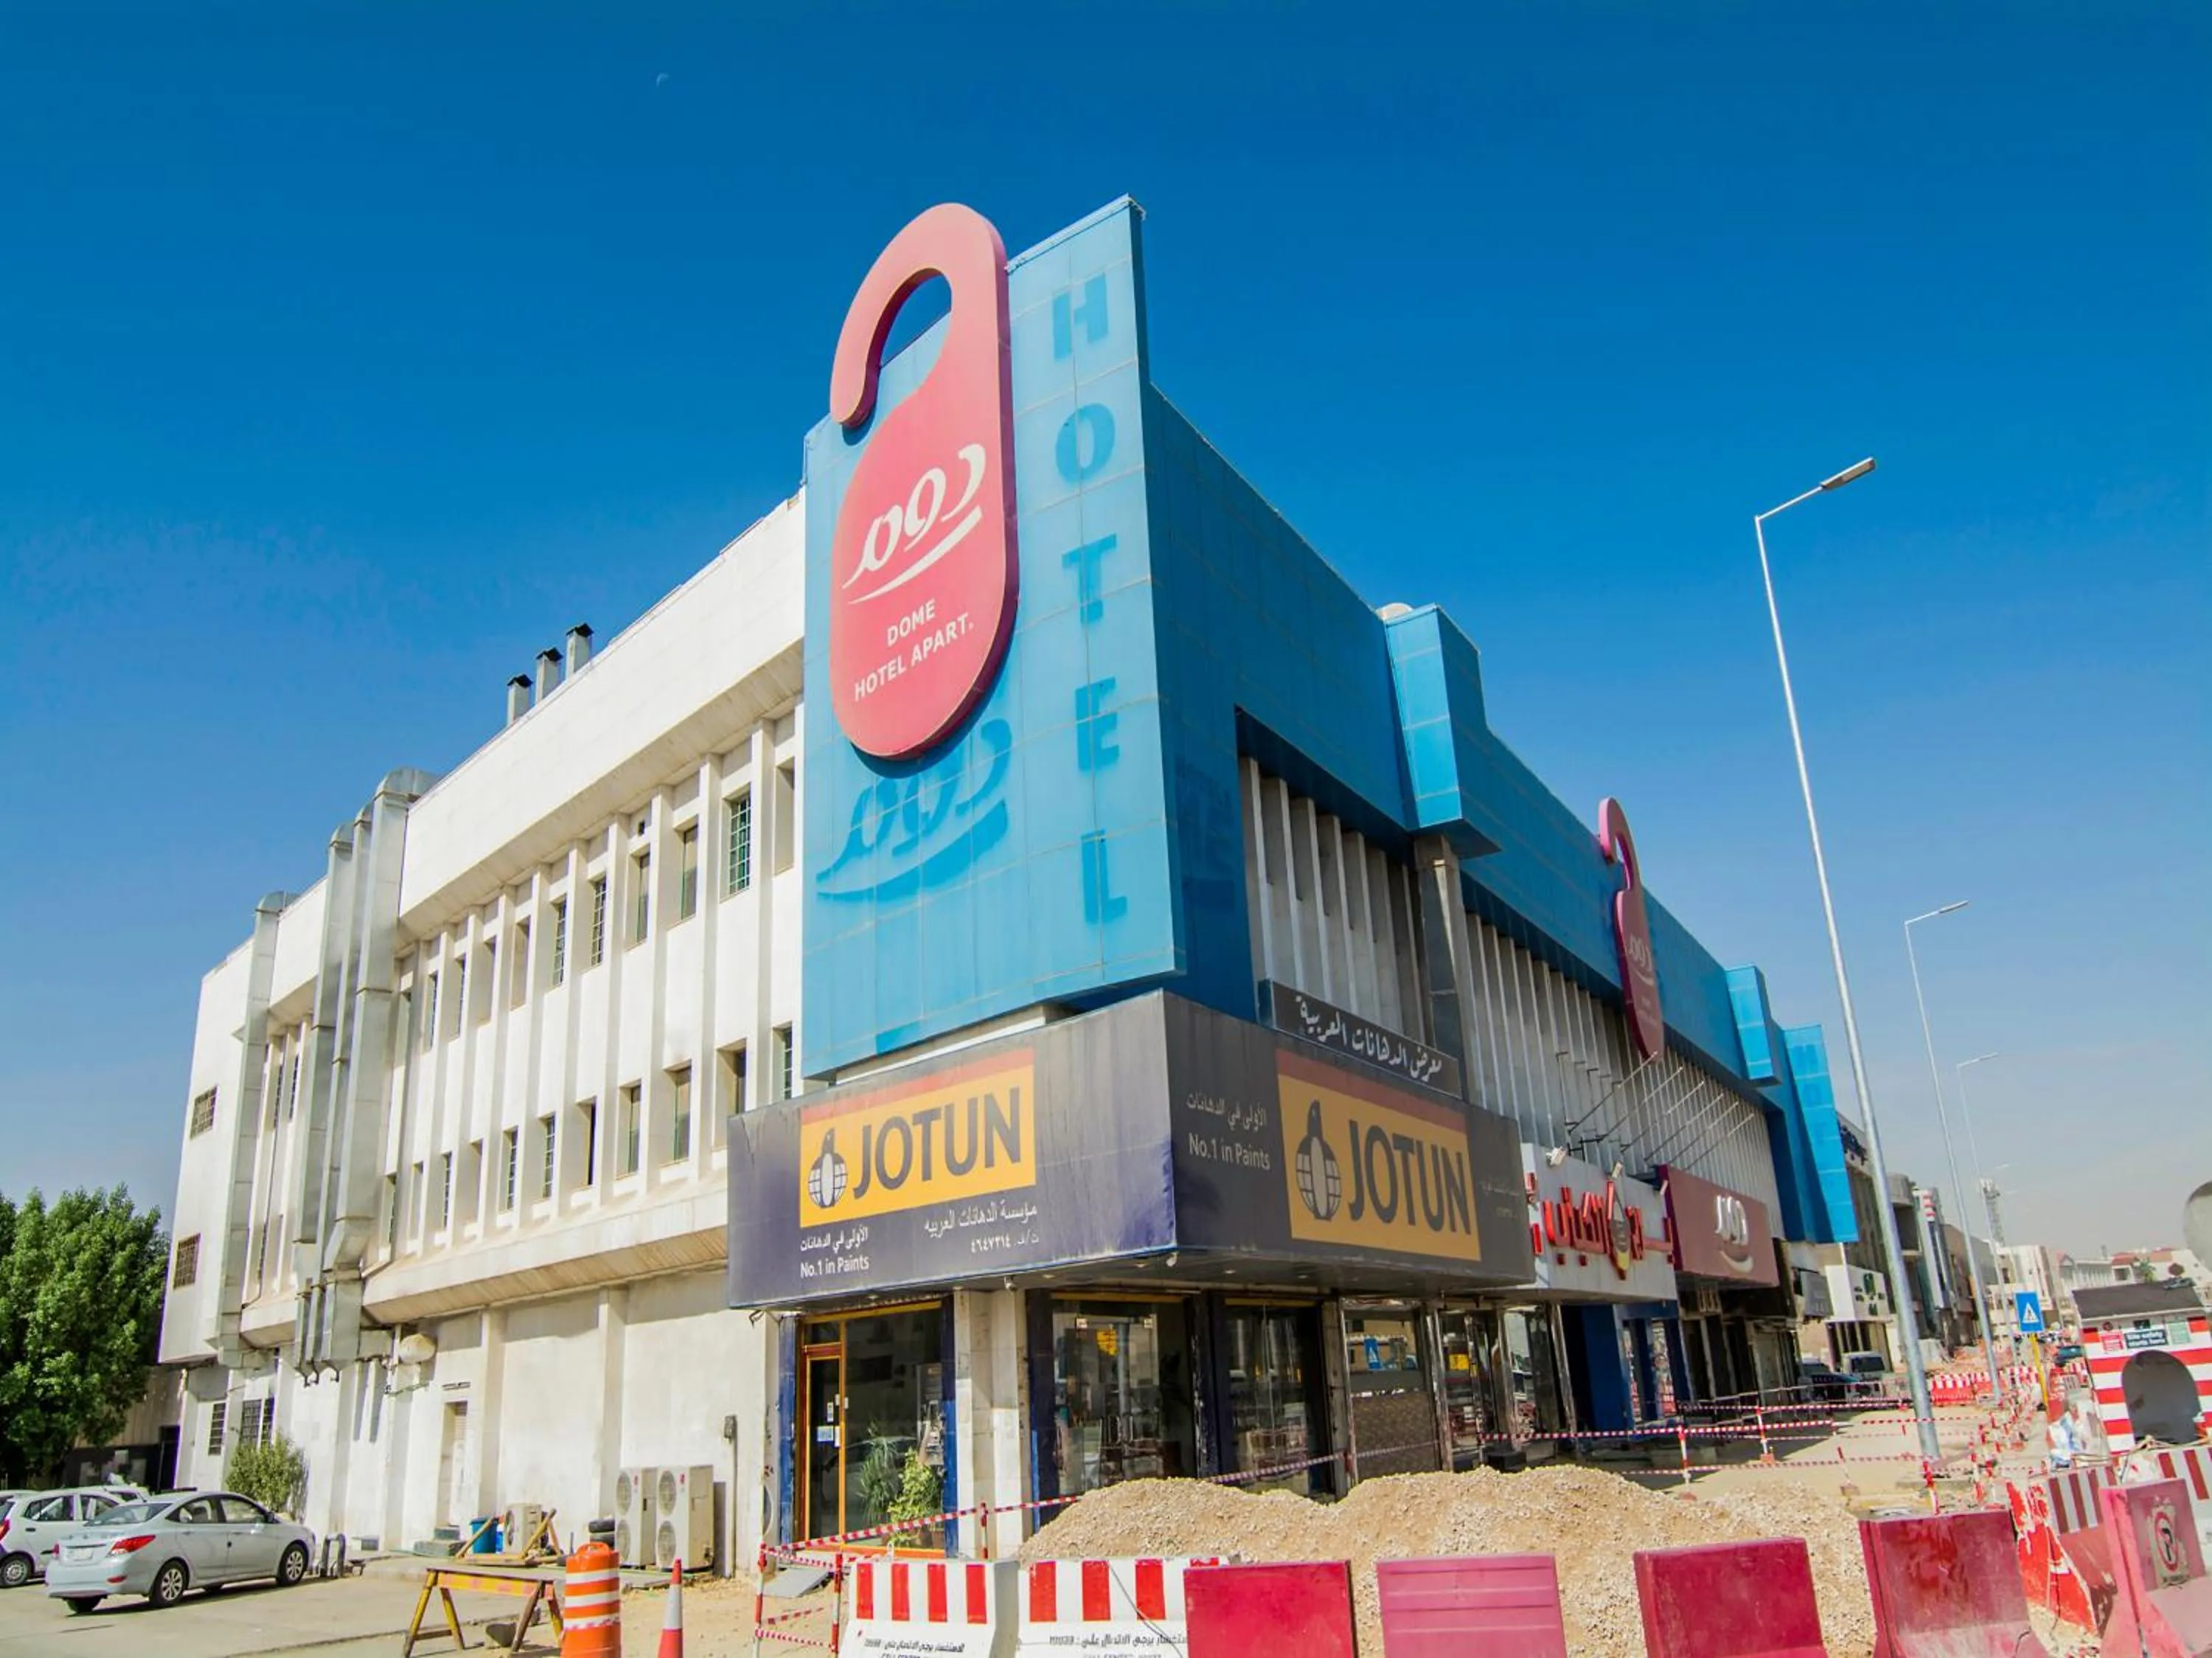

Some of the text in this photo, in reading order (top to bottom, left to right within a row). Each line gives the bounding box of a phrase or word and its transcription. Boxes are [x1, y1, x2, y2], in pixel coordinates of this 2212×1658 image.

[886, 597, 936, 647] DOME
[1051, 271, 1128, 926] HOTEL
[853, 653, 907, 702] HOTEL
[1295, 995, 1442, 1083] معرض الدهانات العربية
[852, 1086, 1021, 1200] JOTUN
[1189, 1132, 1270, 1172] No.1 in Paints
[1348, 1119, 1471, 1235] JOTUN
[958, 1201, 998, 1227] الدهانات
[1000, 1199, 1038, 1224] مؤسسة
[800, 1254, 870, 1280] No.1 in Paints
